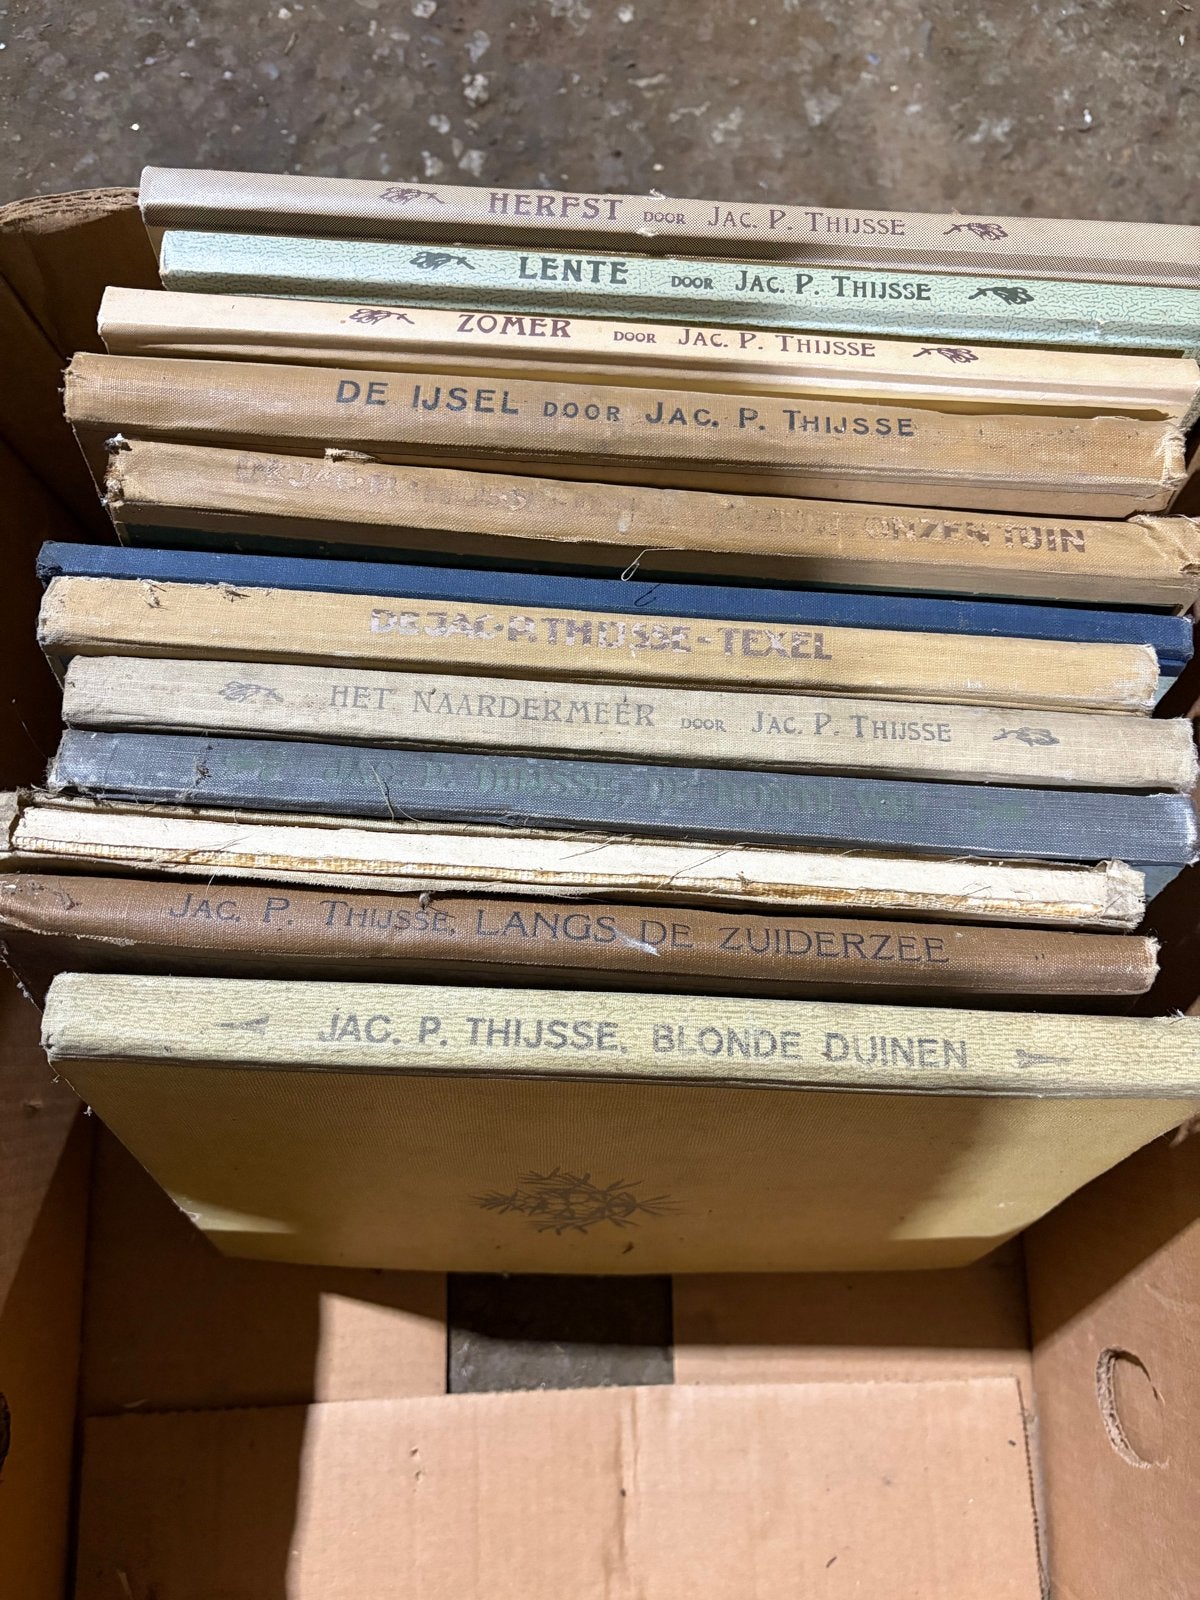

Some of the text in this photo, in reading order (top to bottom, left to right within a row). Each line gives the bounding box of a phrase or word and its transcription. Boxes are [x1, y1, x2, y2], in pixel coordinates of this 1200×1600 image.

[489, 192, 905, 236] HERFST DOOR JAC. P. THIJSSE
[518, 256, 932, 301] LENTE DOOR JAC. P. THIJSSE
[457, 314, 875, 357] ZOMER DOOR JAC. P. THIJSSE
[336, 380, 914, 437] DE IJSEL DOOR JAC. P. THIJSSE
[1000, 522, 1086, 553] TUIN
[717, 626, 833, 660] TEXEL
[331, 684, 951, 743] HET NAARDERMEER DOOR JAC. P. THIJSSE
[169, 893, 240, 922] JAC.
[263, 897, 293, 925] P.
[476, 909, 616, 943] LANGS
[640, 919, 693, 948] DE
[718, 927, 950, 964] ZUIDERZEE
[318, 1014, 401, 1046] JAC.
[418, 1016, 448, 1047] P.
[652, 1023, 802, 1060] BLONDE
[821, 1031, 968, 1069] DUINEN
